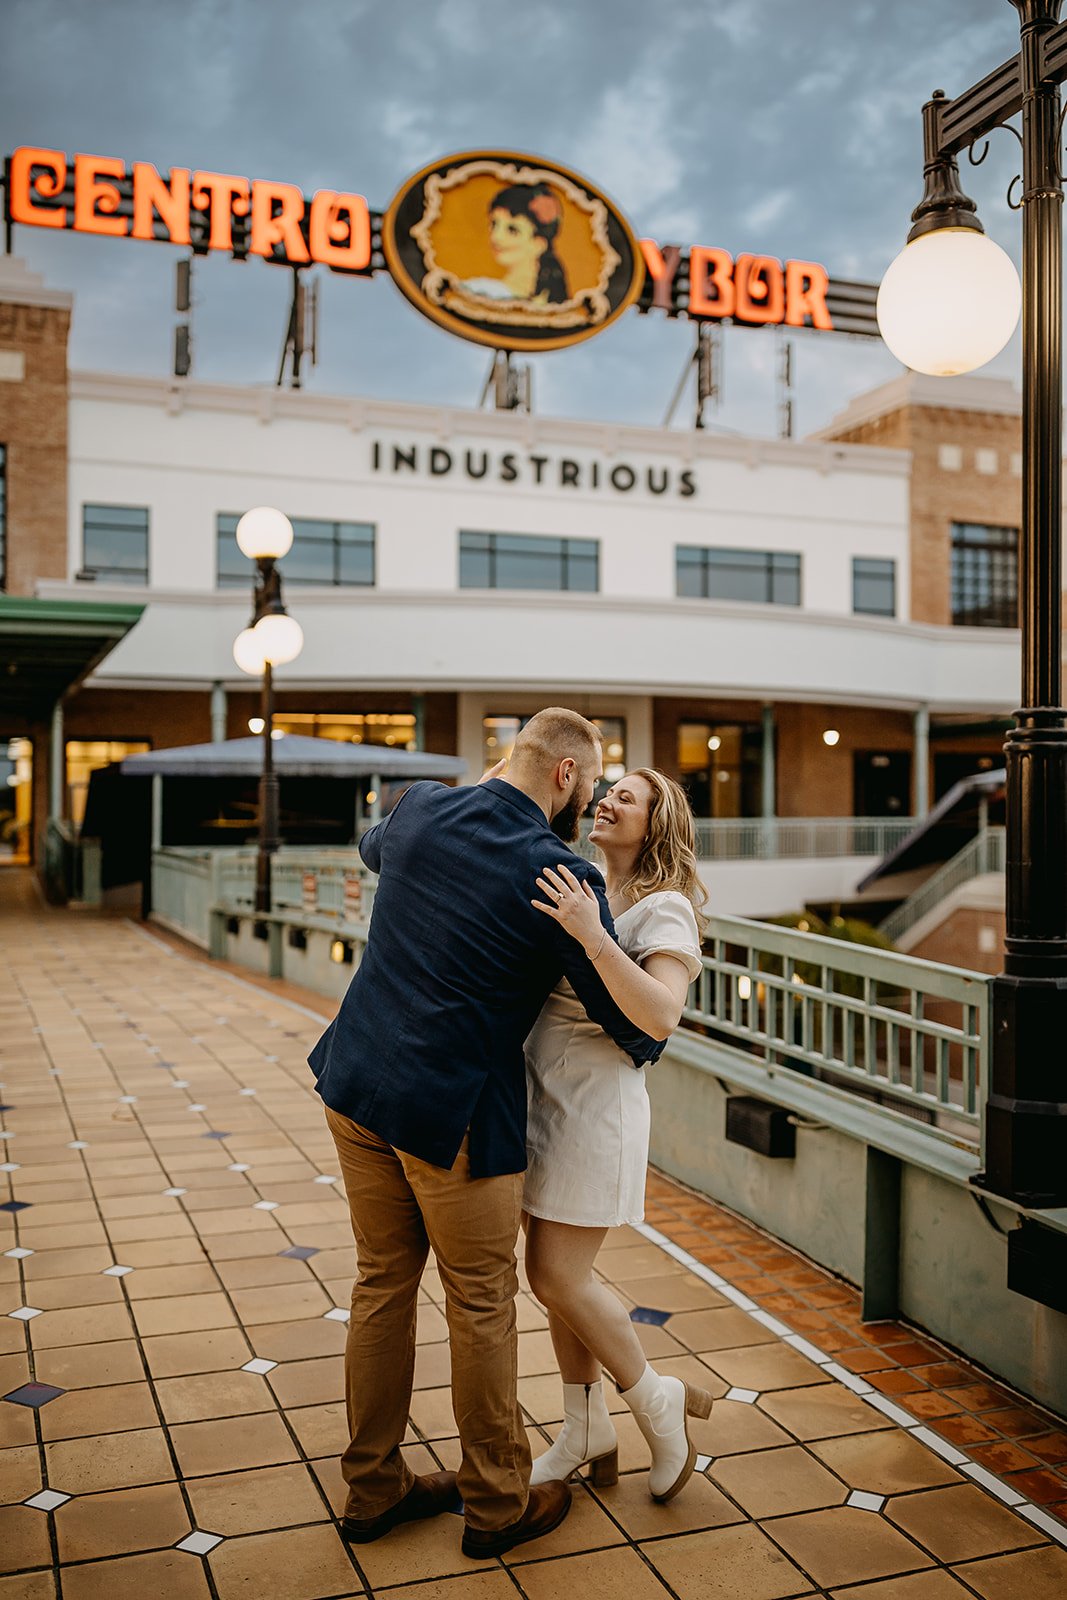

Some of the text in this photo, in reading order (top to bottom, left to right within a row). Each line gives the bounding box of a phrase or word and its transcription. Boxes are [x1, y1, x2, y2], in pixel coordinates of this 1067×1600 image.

[10, 146, 834, 330] CENTRO YBOR
[372, 441, 698, 497] INDUSTRIOUS
